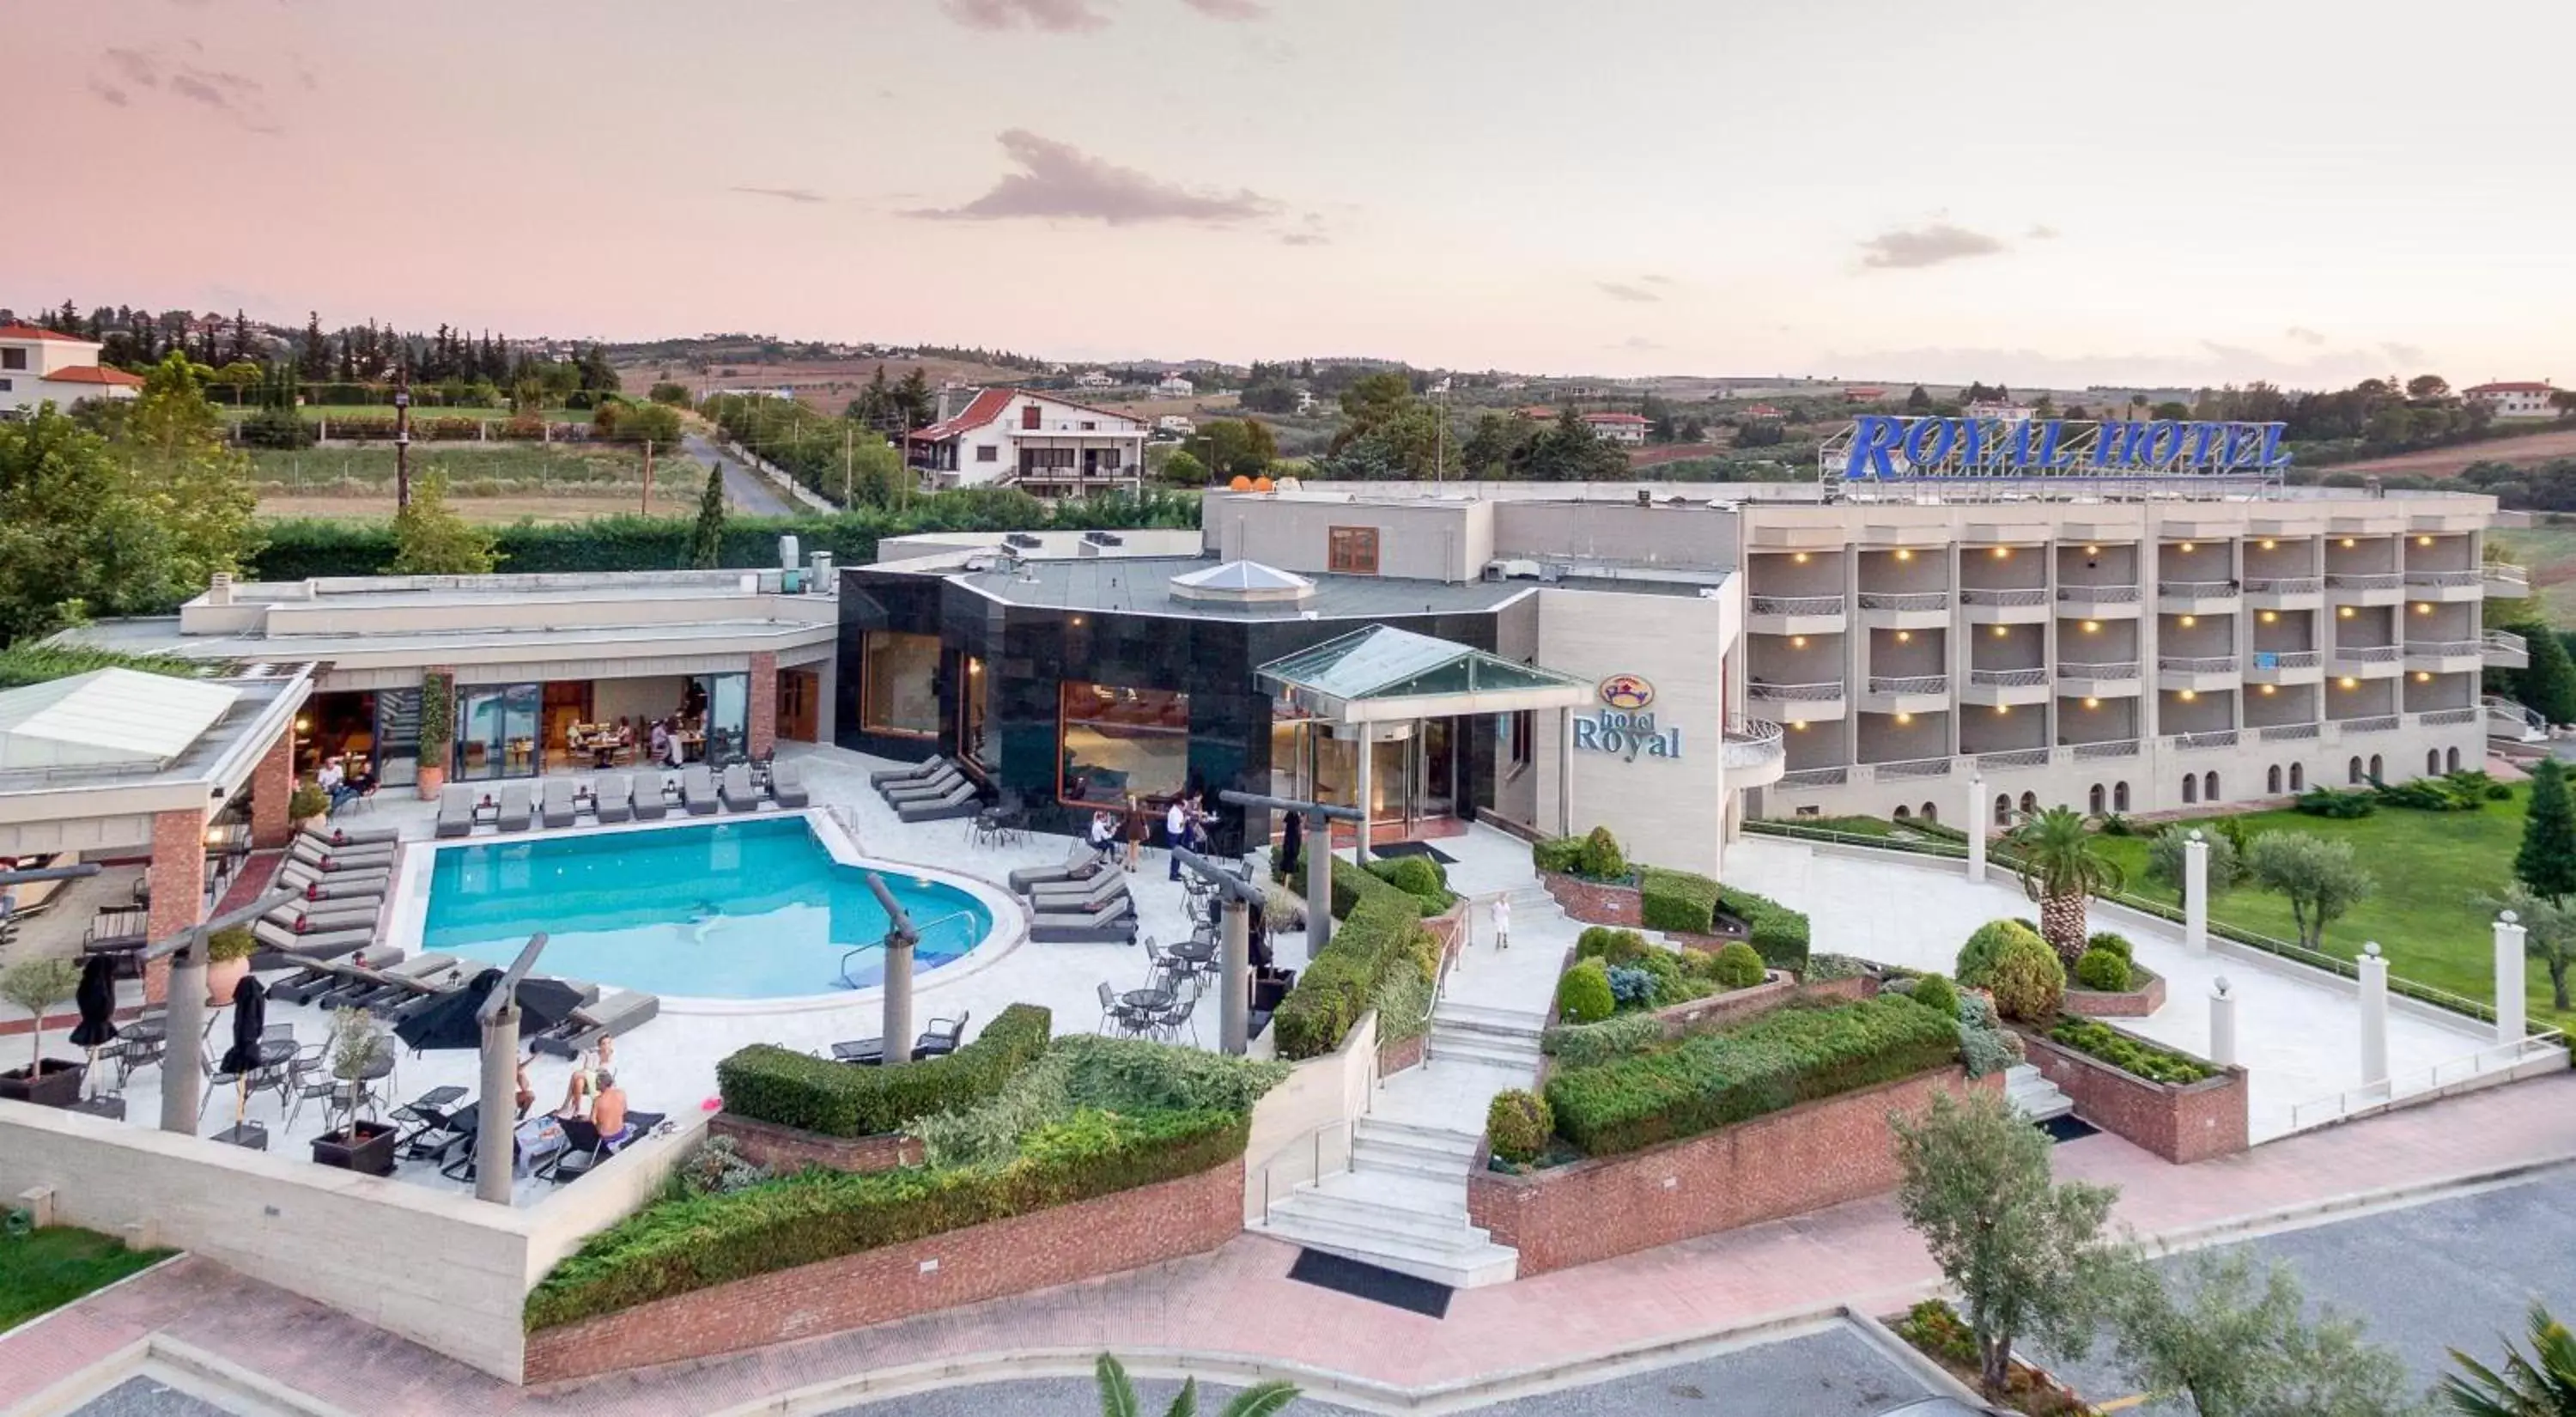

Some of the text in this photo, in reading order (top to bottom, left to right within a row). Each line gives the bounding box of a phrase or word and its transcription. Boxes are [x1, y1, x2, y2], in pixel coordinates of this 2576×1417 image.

[1844, 416, 2293, 480] ROYAL HOTEL
[1573, 716, 1680, 763] Royal
[1600, 708, 1655, 732] hotel
